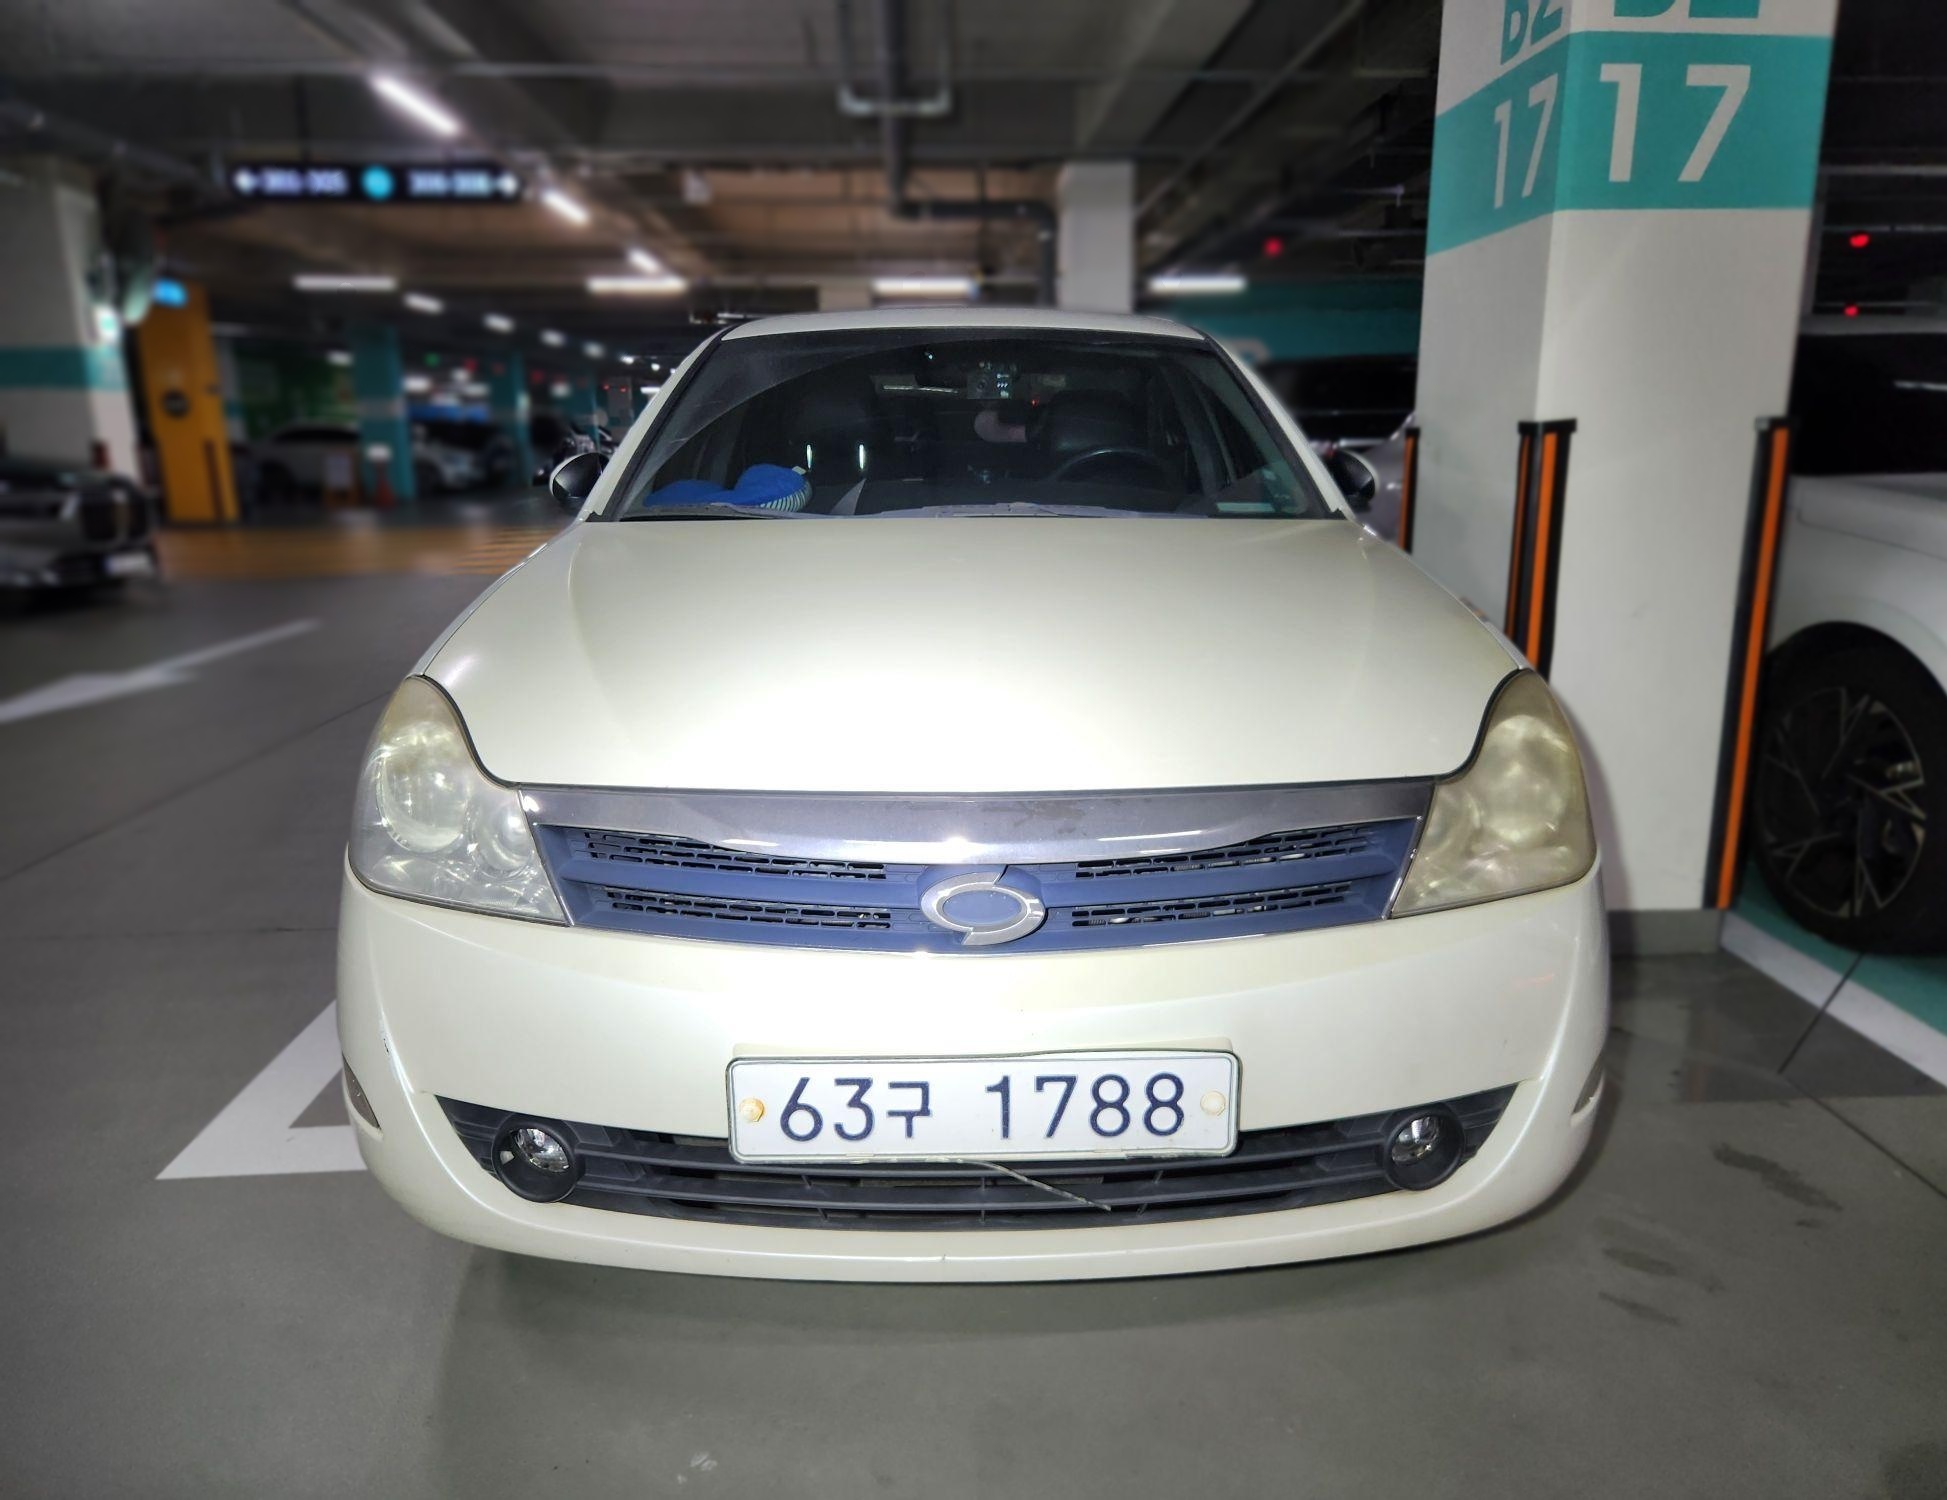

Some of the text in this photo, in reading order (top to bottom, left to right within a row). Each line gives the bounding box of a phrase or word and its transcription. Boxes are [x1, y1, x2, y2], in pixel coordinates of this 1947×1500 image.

[1494, 74, 1558, 209] 17
[1600, 63, 1752, 183] 17
[779, 1072, 1186, 1142] 63구 1788
